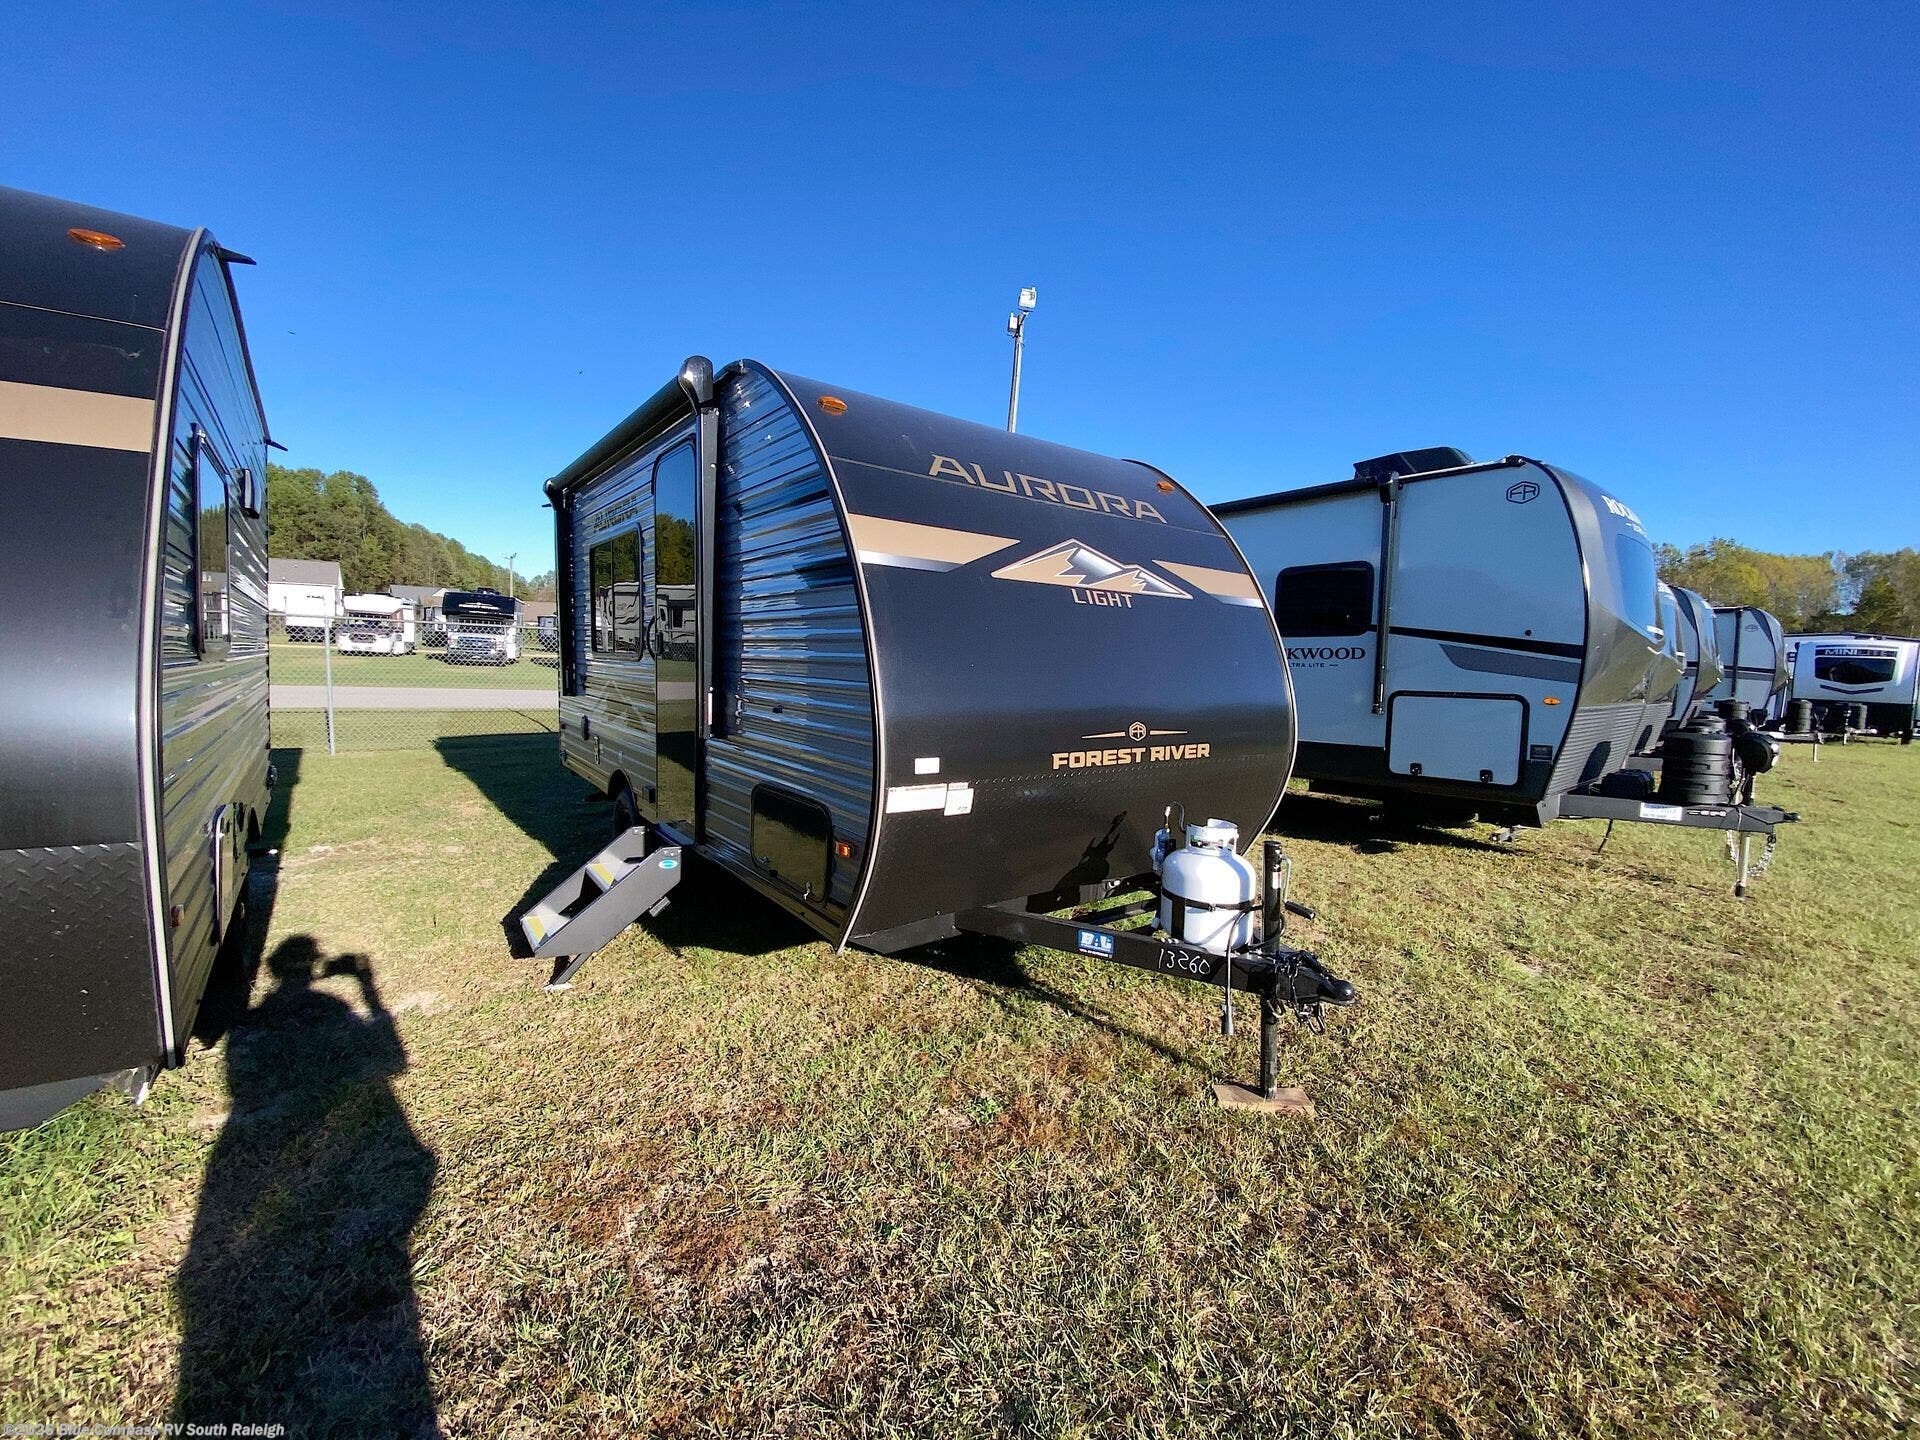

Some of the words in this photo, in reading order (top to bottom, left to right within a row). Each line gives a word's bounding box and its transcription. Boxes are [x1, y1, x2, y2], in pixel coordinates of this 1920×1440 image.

[929, 453, 1167, 524] AURORA
[1072, 588, 1133, 608] LIGHT
[1284, 647, 1365, 660] KWOOD
[1052, 747, 1146, 770] FOREST
[1149, 743, 1210, 762] RIVER
[1159, 948, 1210, 975] 13260
